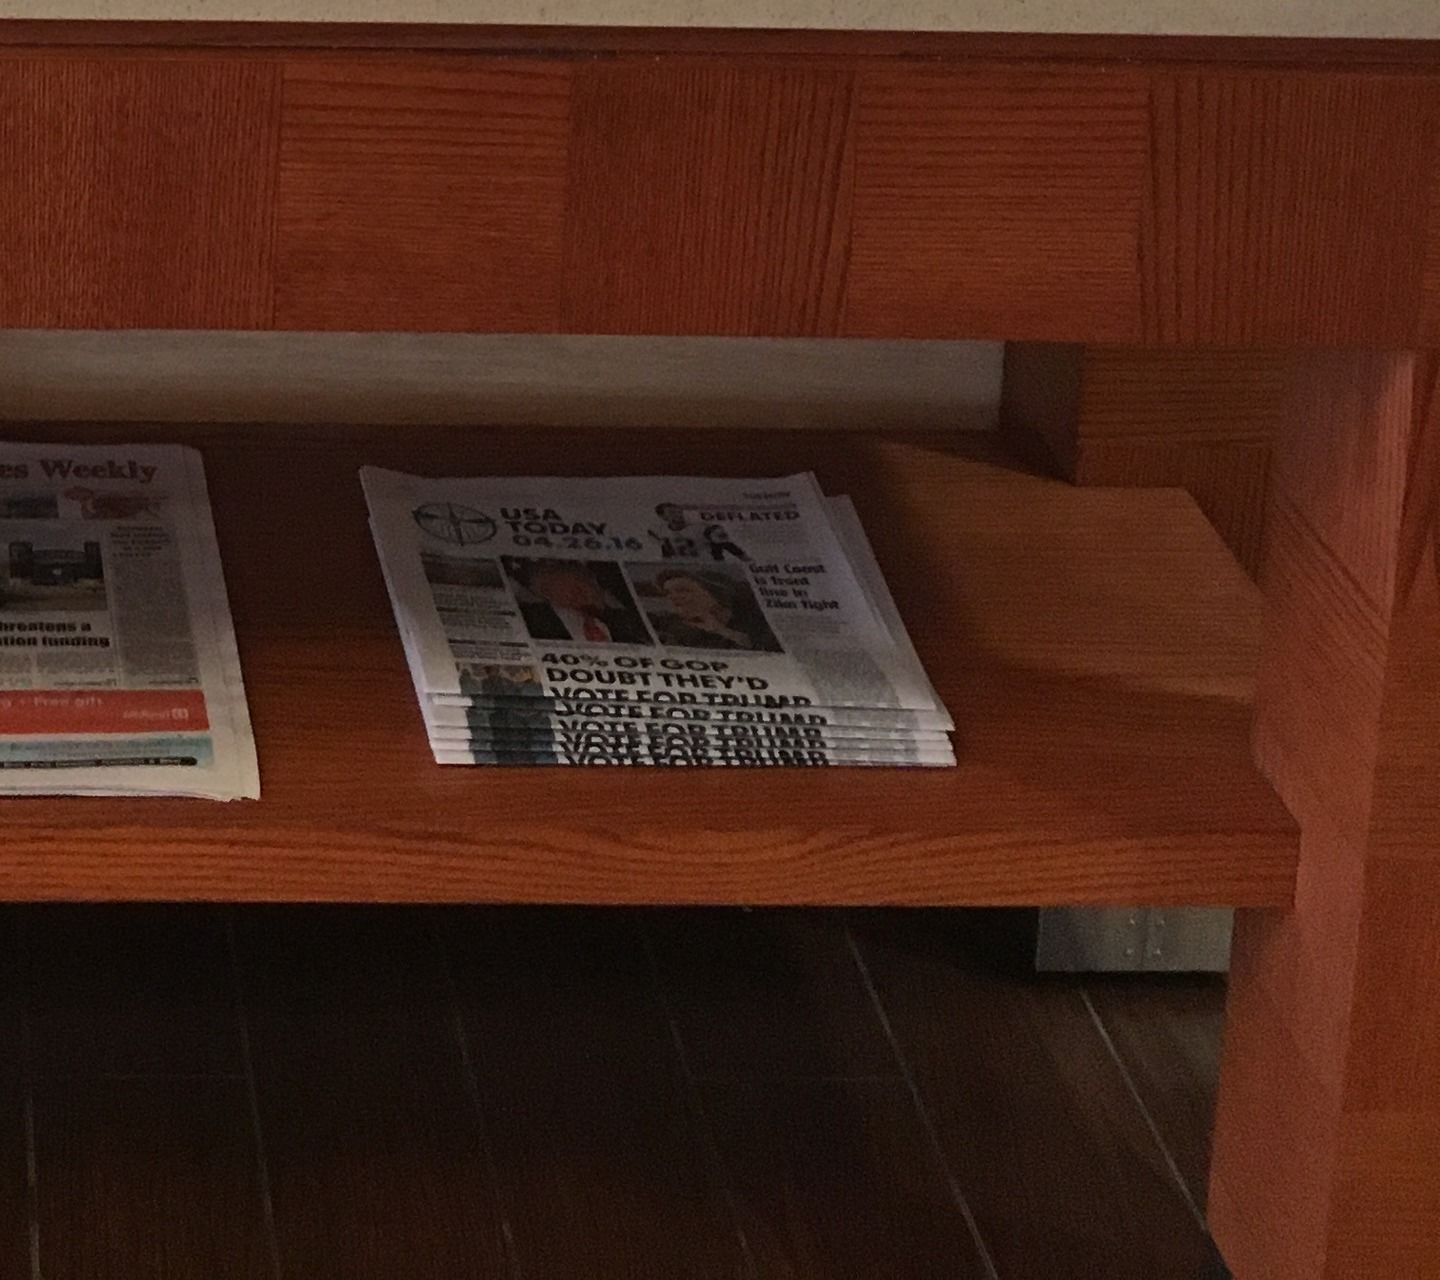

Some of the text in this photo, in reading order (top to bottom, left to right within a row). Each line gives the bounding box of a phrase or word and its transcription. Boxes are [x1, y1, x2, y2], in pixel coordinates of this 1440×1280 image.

[40, 459, 158, 483] Weekly
[500, 507, 561, 522] USA
[700, 509, 800, 523] DEFLATED
[504, 521, 607, 536] TODAY
[41, 636, 110, 649] funding
[541, 652, 729, 673] 40% OF GOP
[546, 667, 769, 691] DOUBT THEY'D
